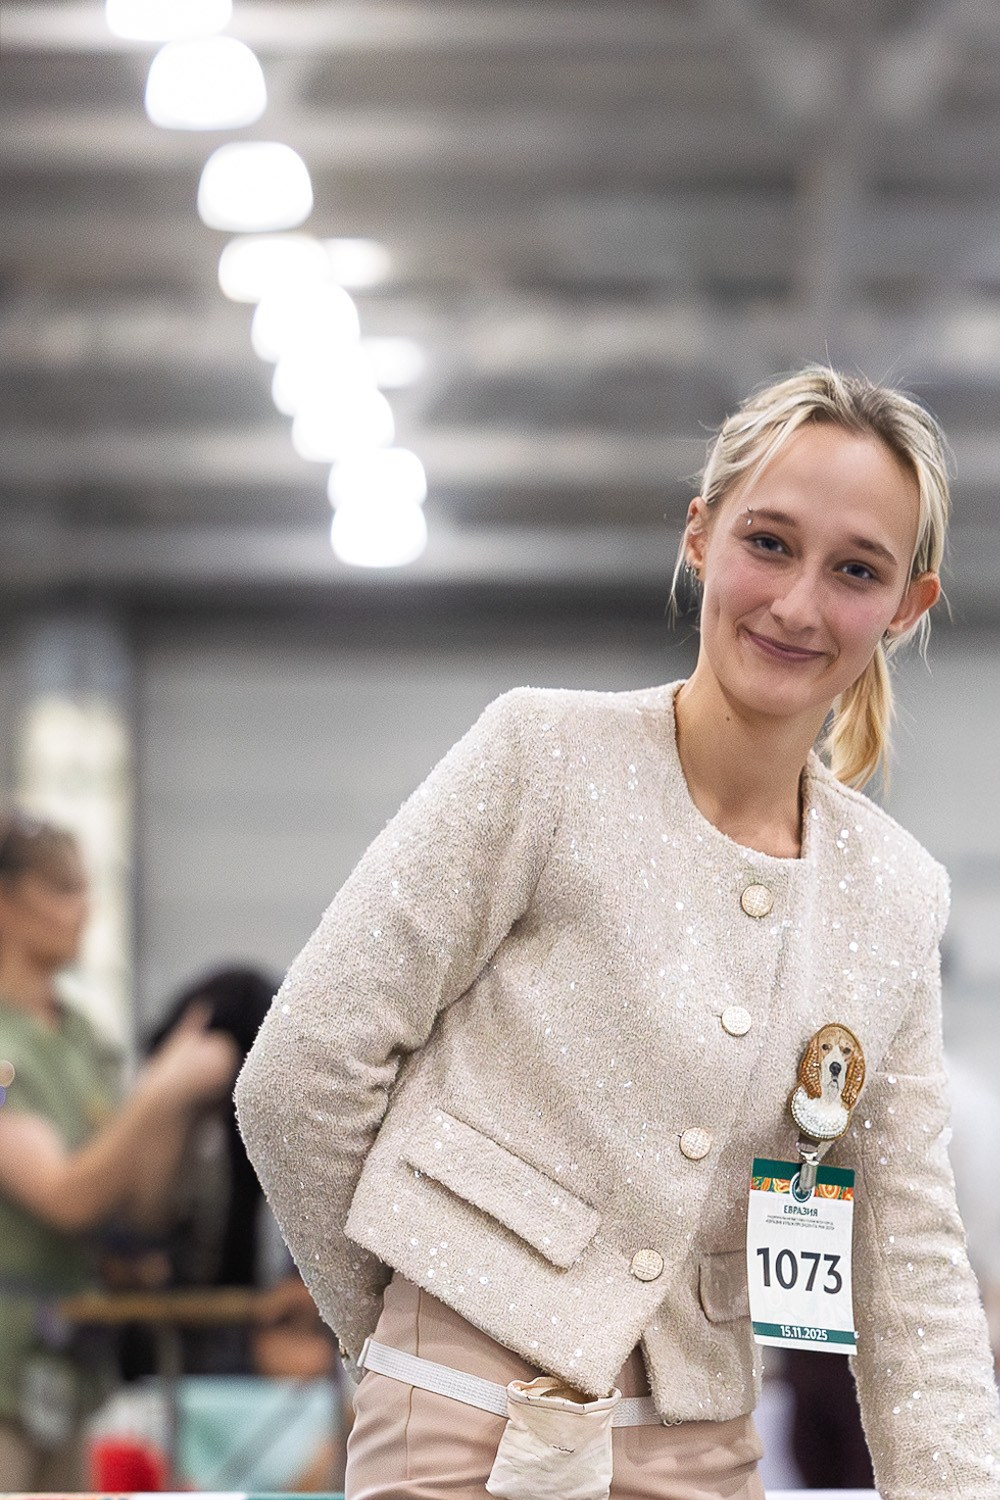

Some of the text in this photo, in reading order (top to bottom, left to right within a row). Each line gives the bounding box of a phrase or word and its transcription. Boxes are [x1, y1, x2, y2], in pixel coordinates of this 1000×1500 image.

[783, 1205, 818, 1217] ЕВРАЗИЯ
[757, 1247, 843, 1294] 1073
[780, 1325, 828, 1341] 15.11.2025
